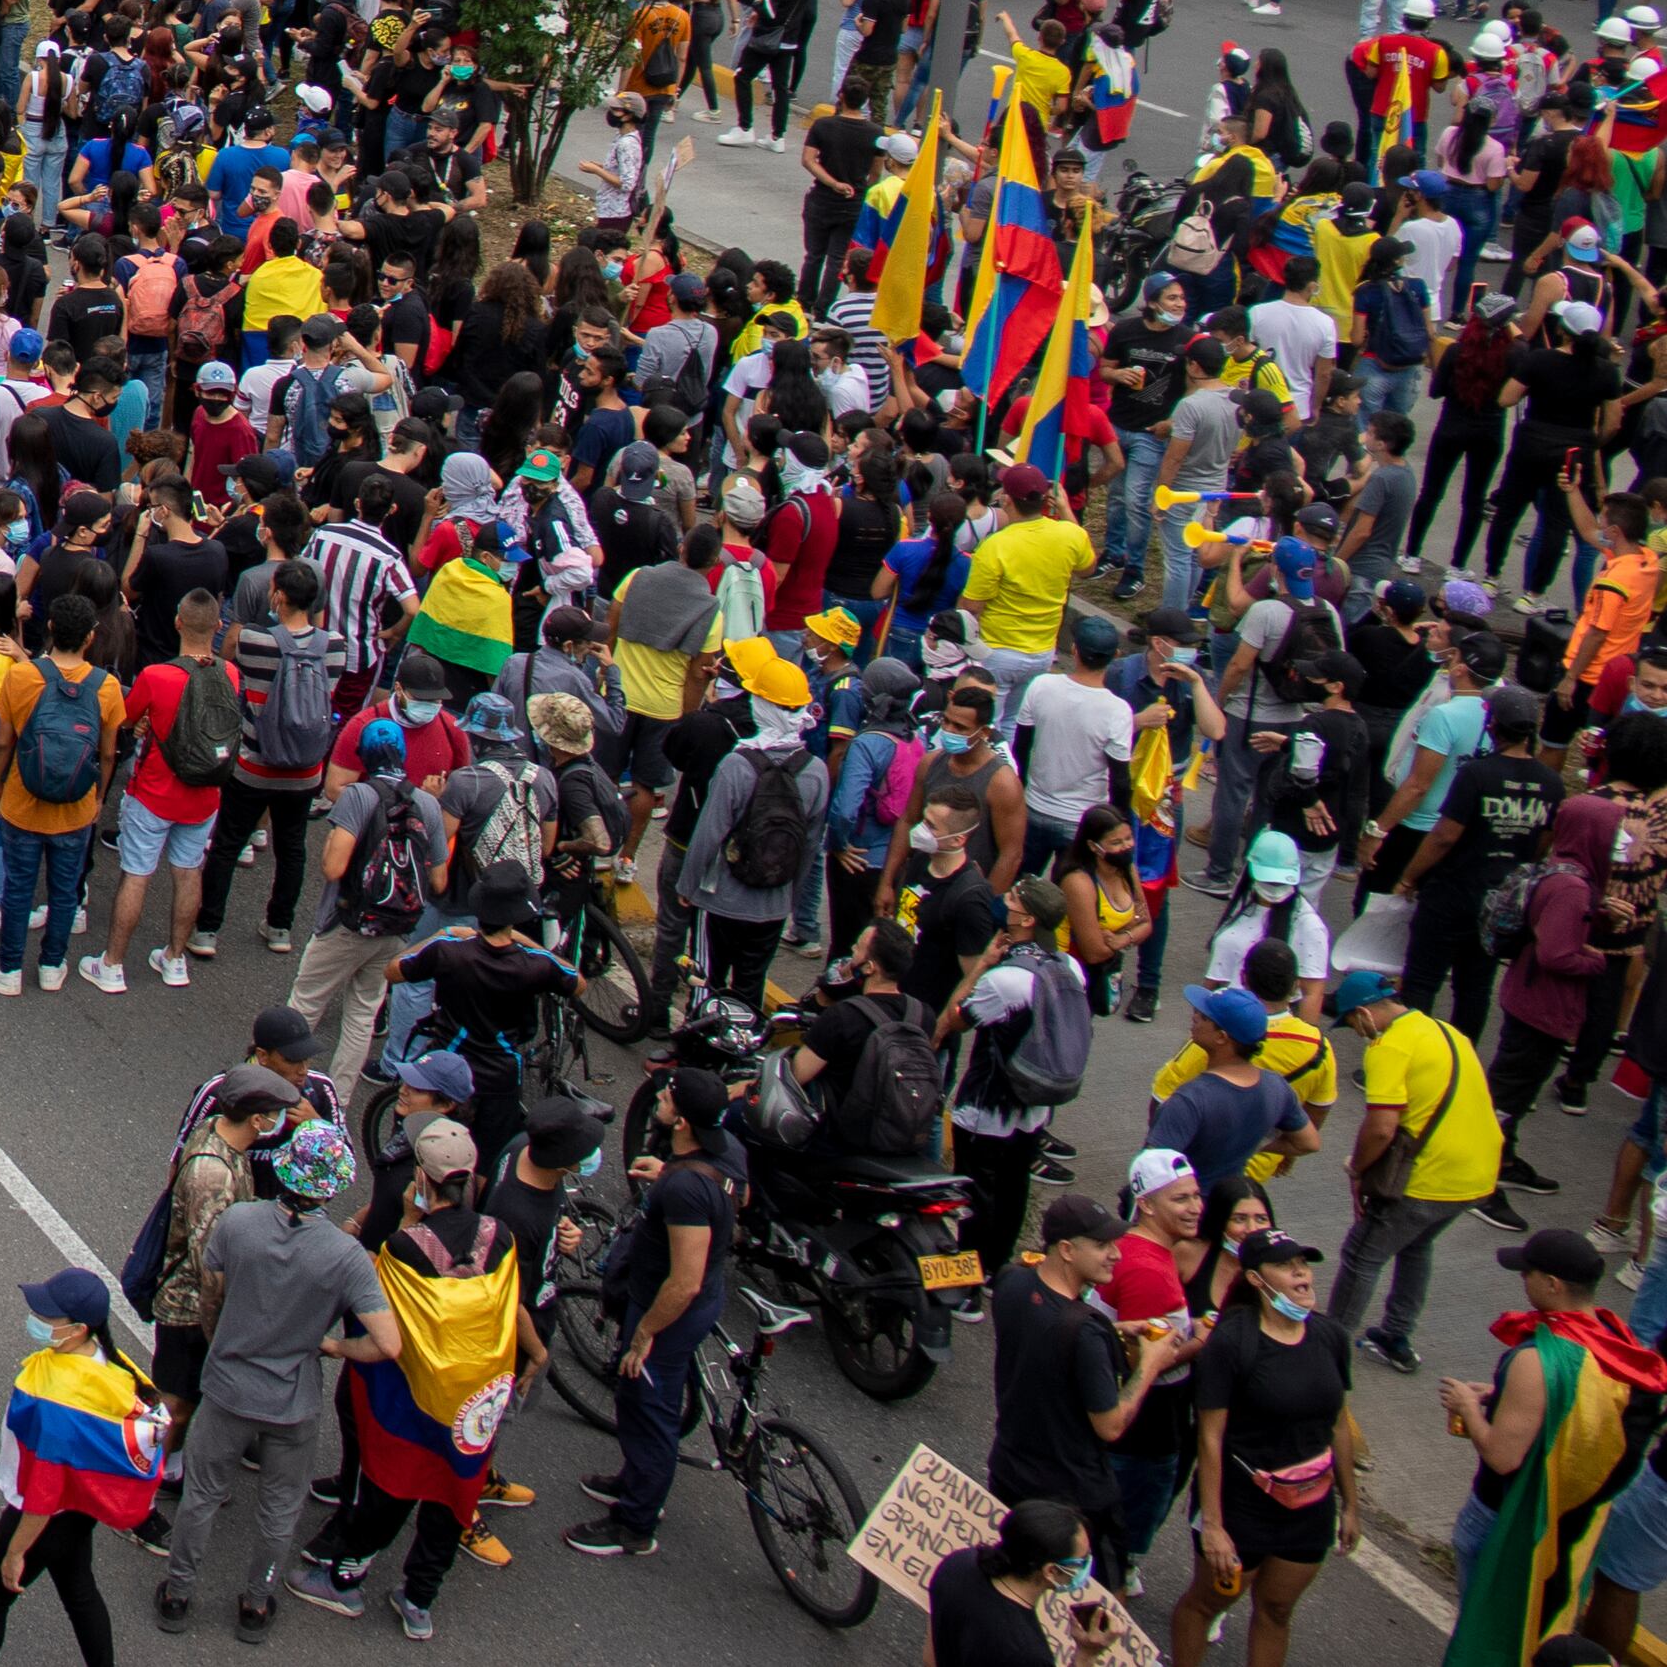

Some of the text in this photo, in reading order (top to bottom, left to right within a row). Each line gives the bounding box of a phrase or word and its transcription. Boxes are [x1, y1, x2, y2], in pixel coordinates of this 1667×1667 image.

[897, 1474, 946, 1526] NOS
[911, 1450, 1013, 1531] CUANDO
[864, 1527, 901, 1562] EN
[880, 1502, 954, 1560] GRAND
